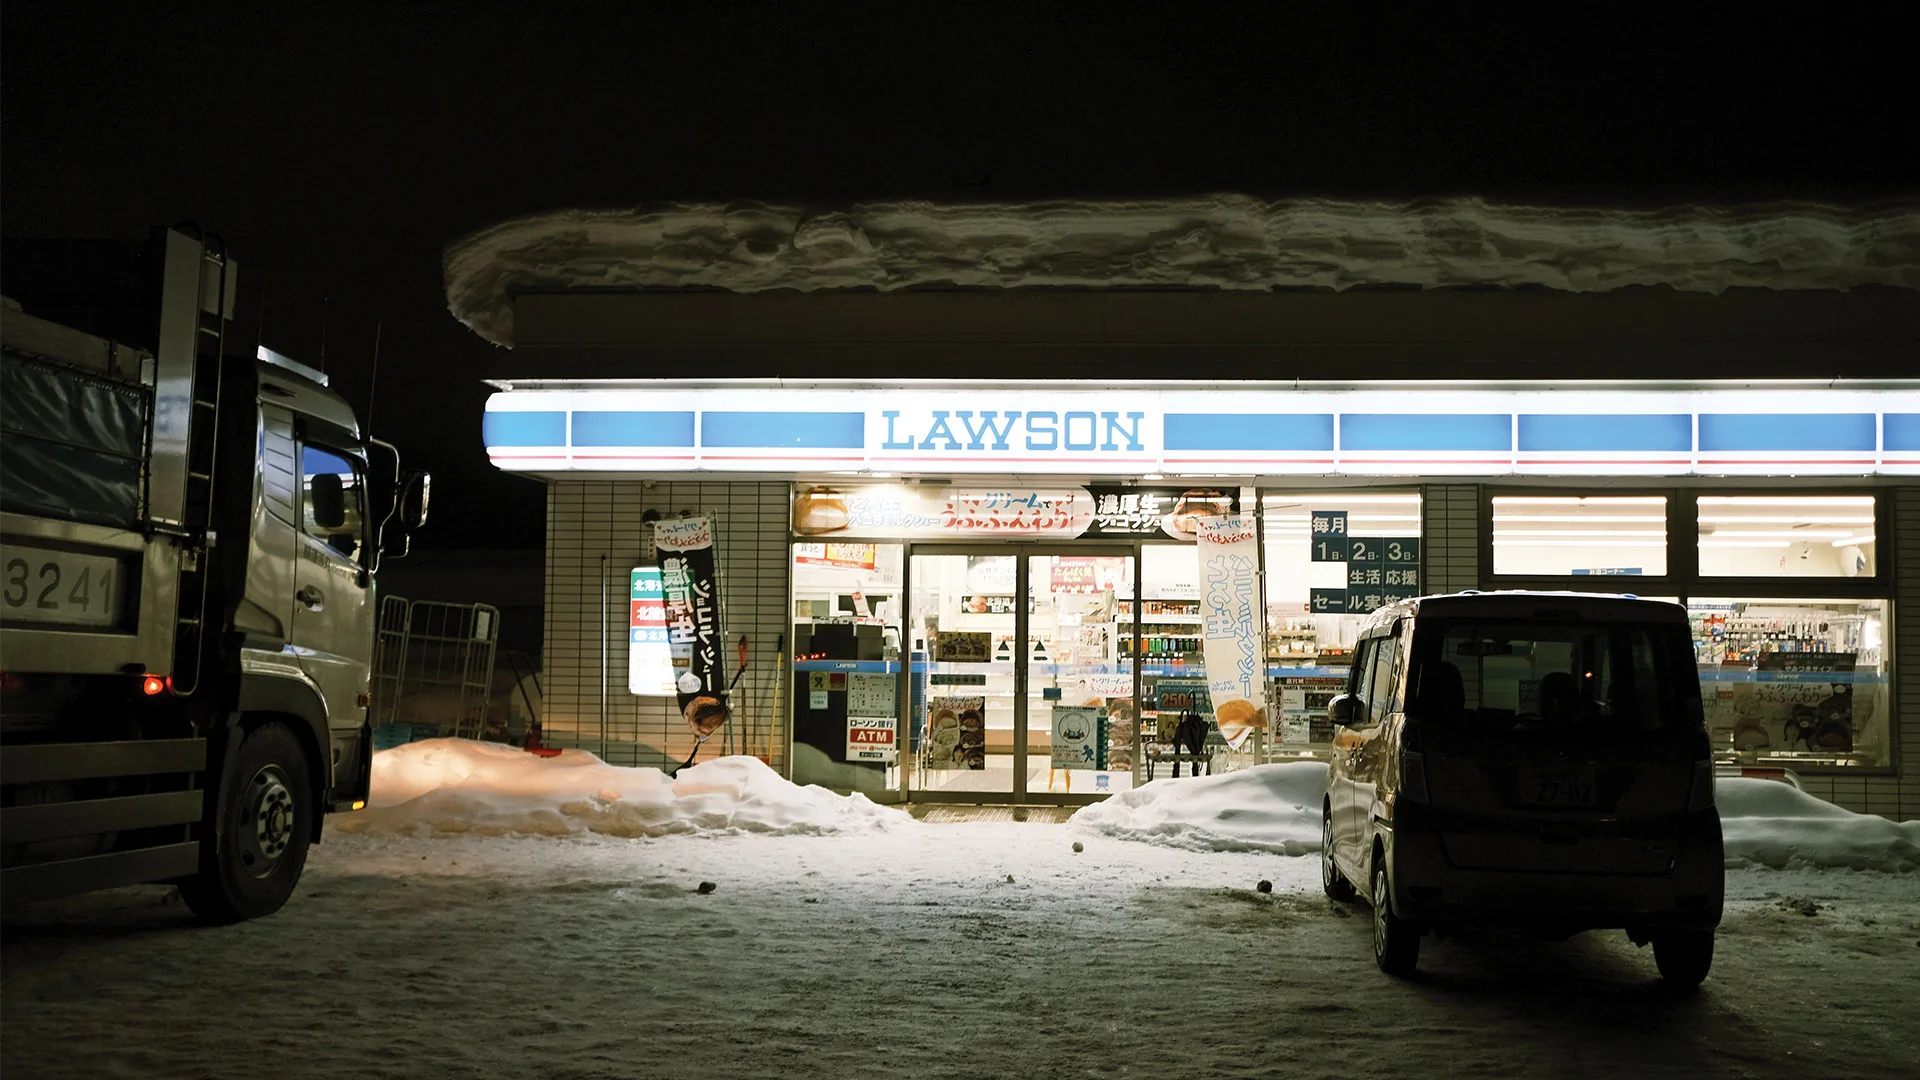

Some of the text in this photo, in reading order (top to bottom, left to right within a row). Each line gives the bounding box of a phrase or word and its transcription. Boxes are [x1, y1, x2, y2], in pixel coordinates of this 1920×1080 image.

[882, 411, 1144, 451] LAWSON
[1097, 494, 1161, 515] 濃厚生
[1312, 516, 1345, 534] 毎月
[4, 558, 112, 614] 3241
[850, 719, 894, 729] ローソン銀行
[856, 731, 888, 743] ATM
